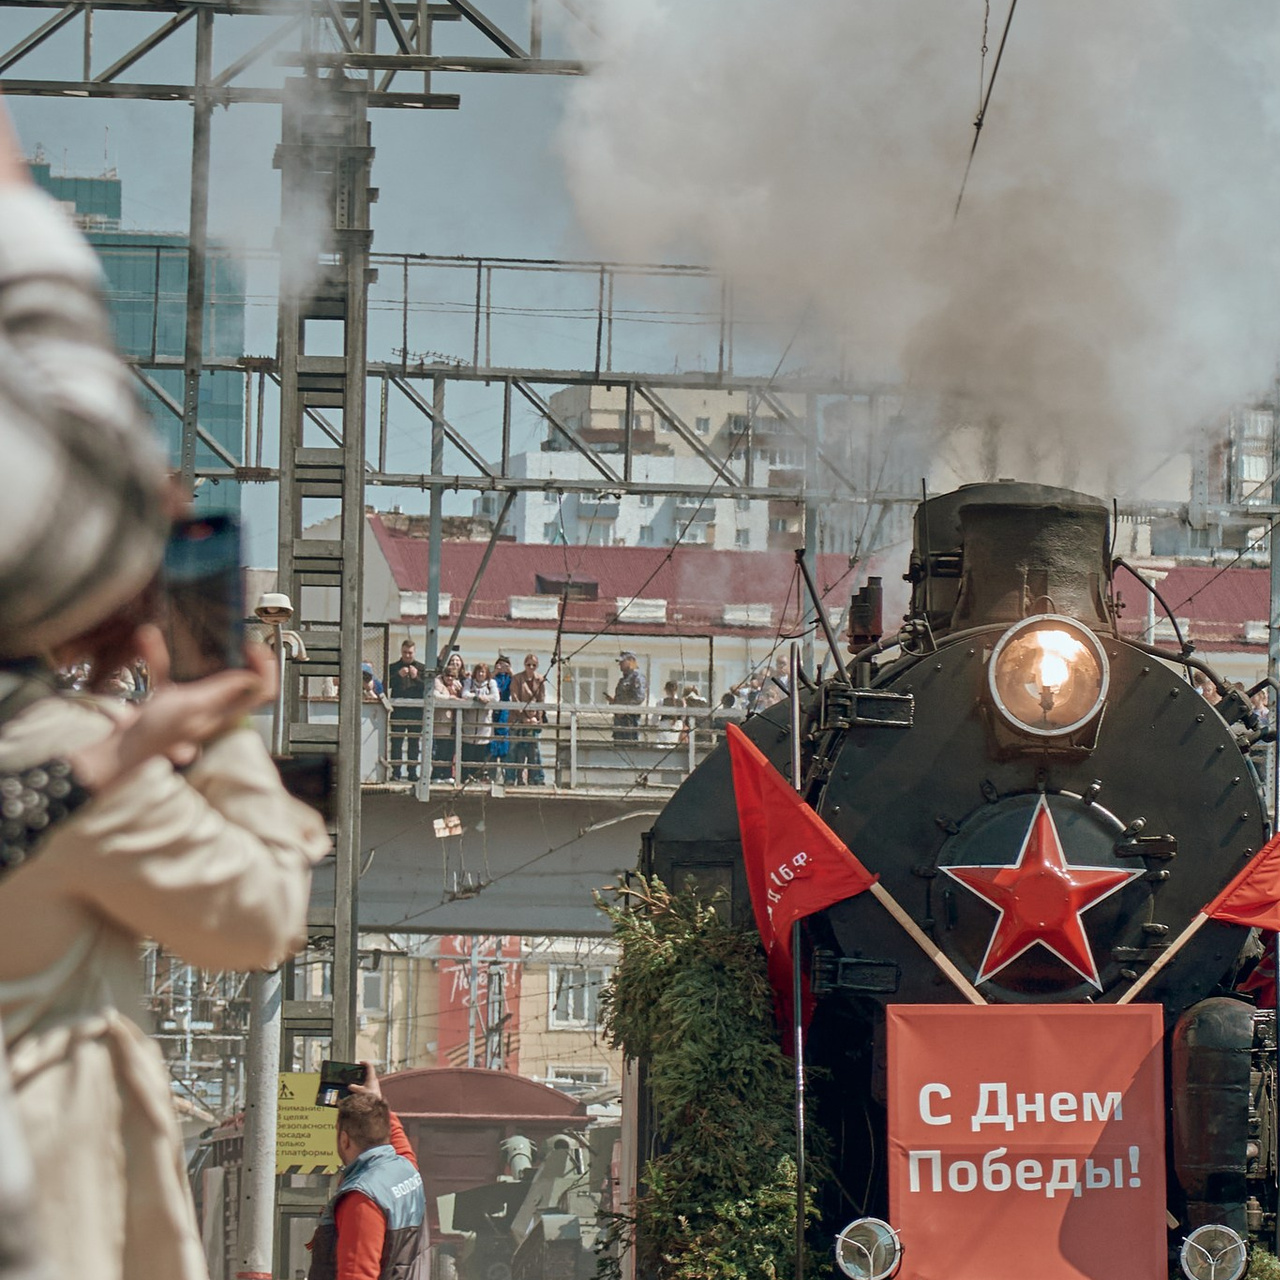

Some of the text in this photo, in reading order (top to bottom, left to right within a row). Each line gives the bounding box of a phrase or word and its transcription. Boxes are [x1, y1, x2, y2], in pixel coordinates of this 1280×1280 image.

[918, 1081, 1123, 1132] С Днем
[281, 1149, 334, 1157] платформы
[908, 1145, 1141, 1198] Победы!
